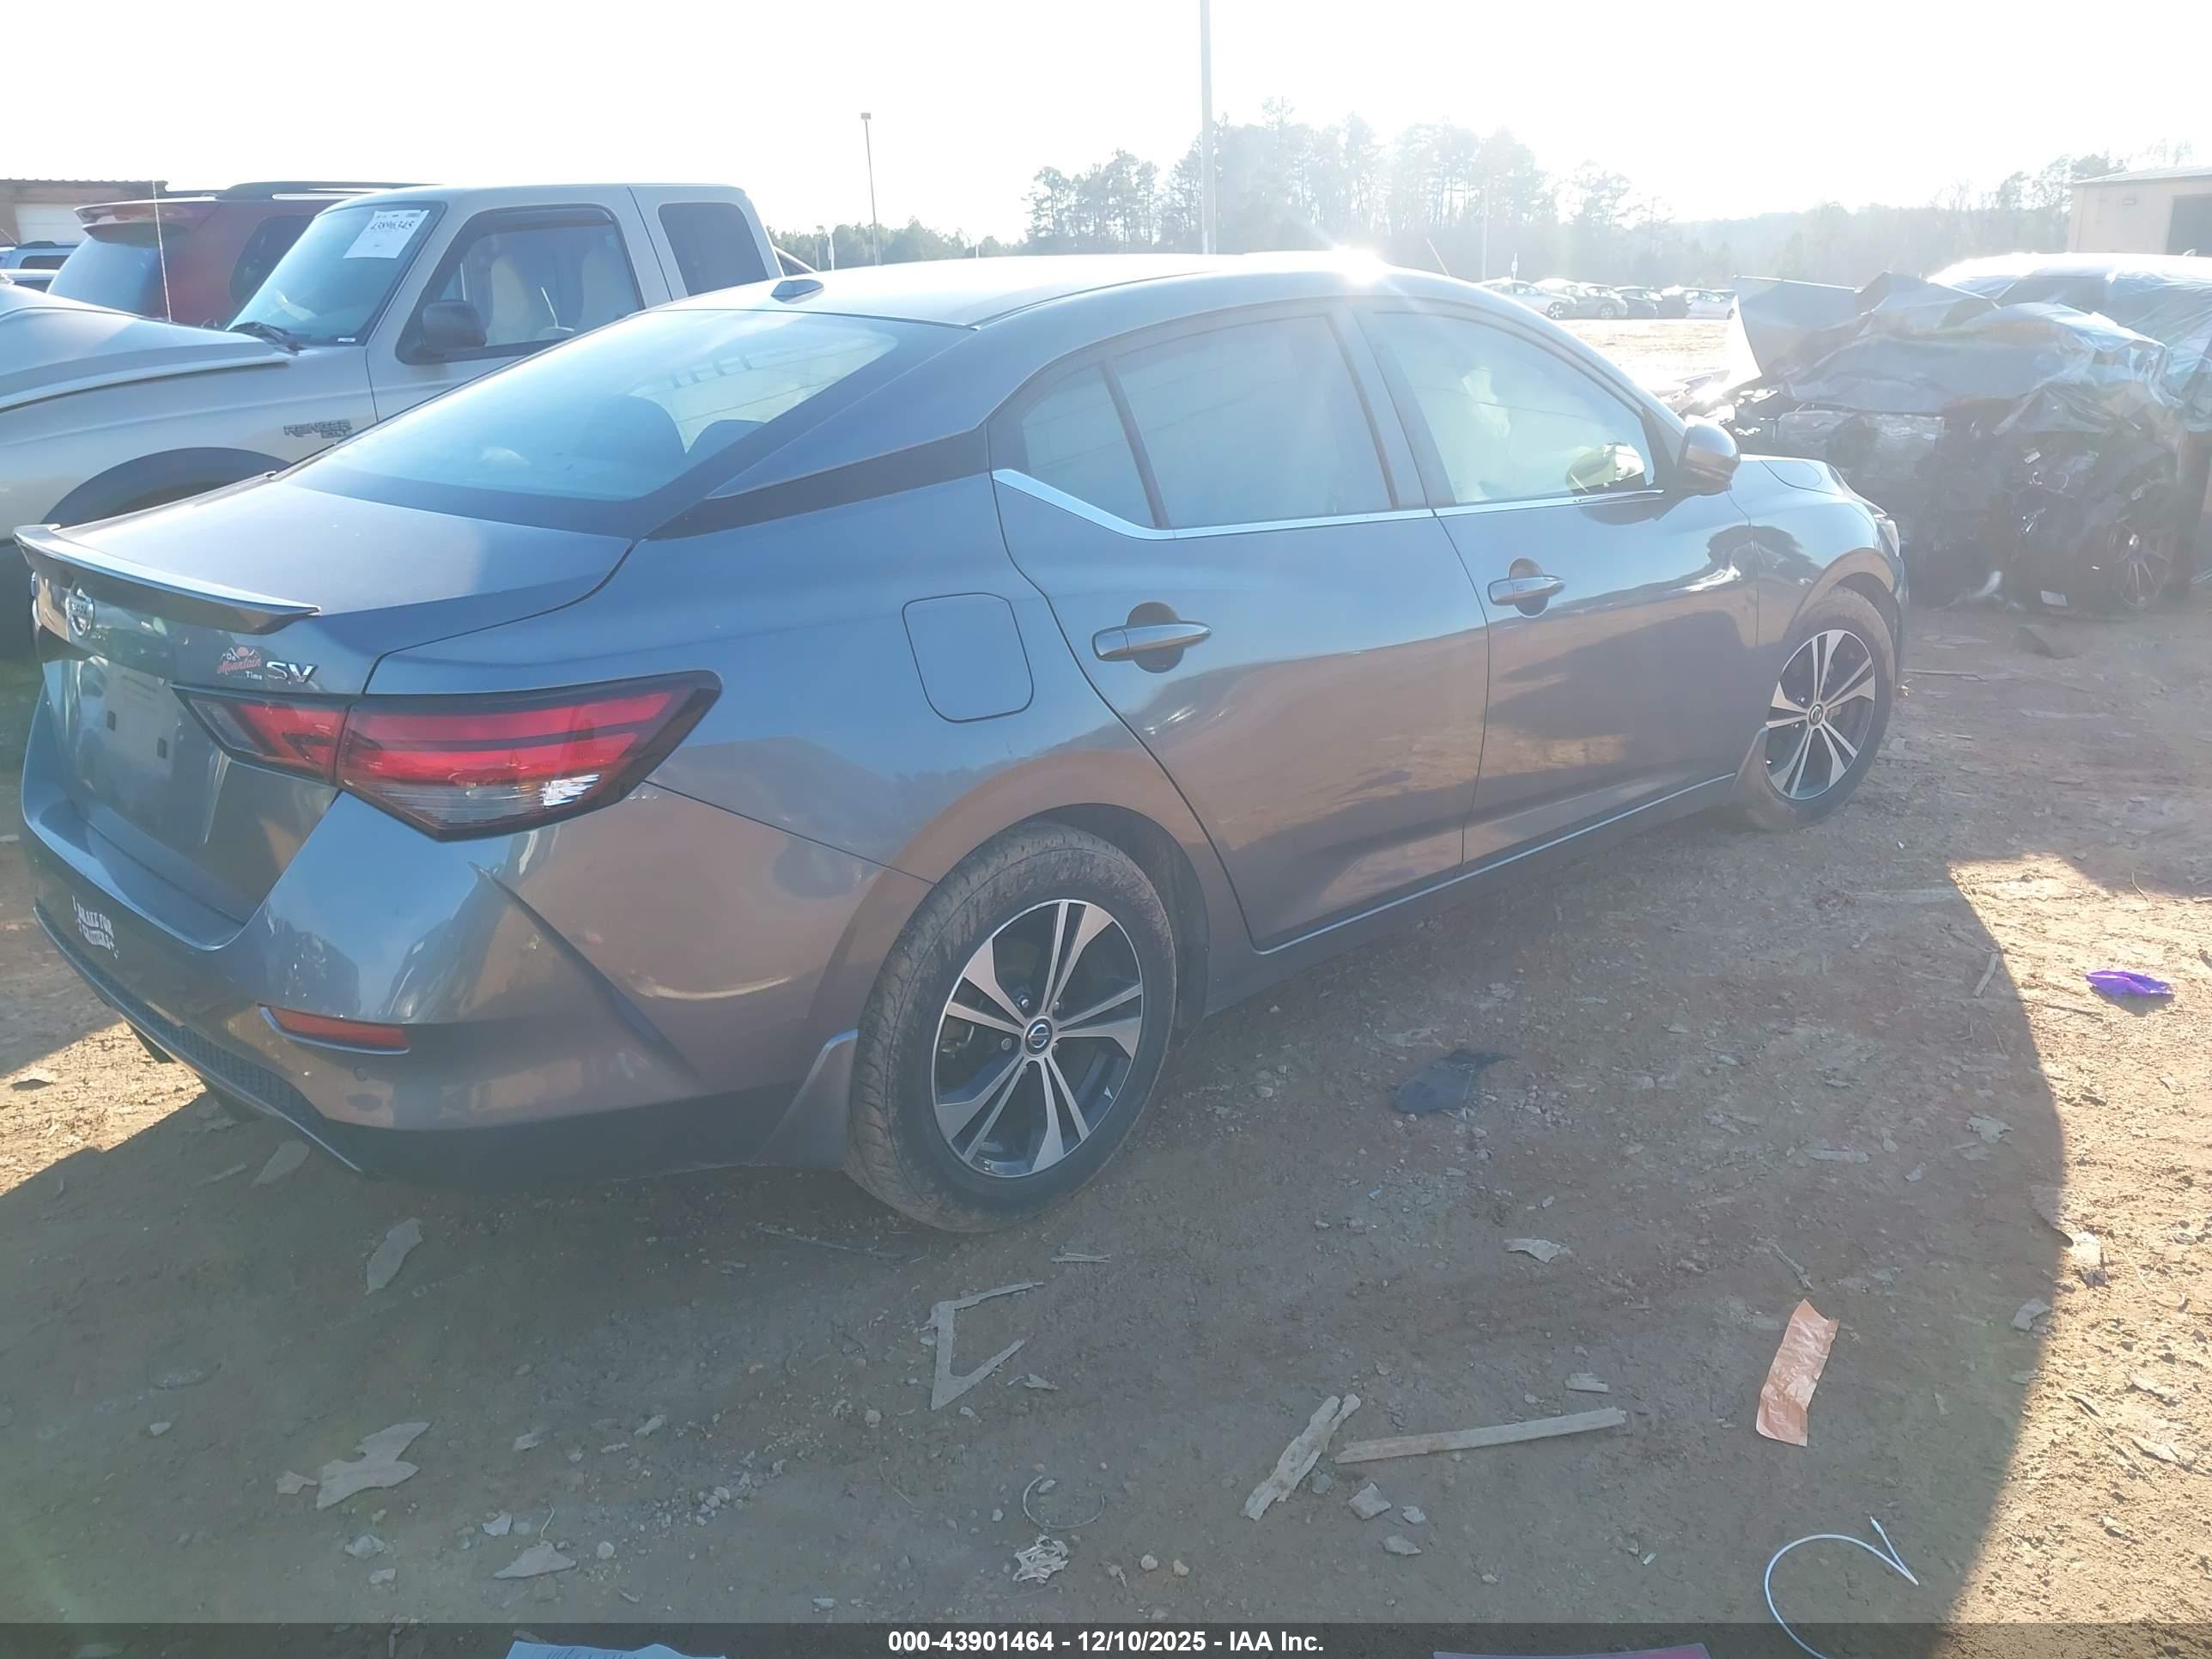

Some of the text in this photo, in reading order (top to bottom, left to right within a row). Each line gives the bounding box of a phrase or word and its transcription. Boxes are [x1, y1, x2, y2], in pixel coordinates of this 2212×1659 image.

[216, 655, 261, 675] Mountain
[246, 671, 263, 680] Time
[266, 660, 318, 683] SV
[99, 913, 115, 939] FOR
